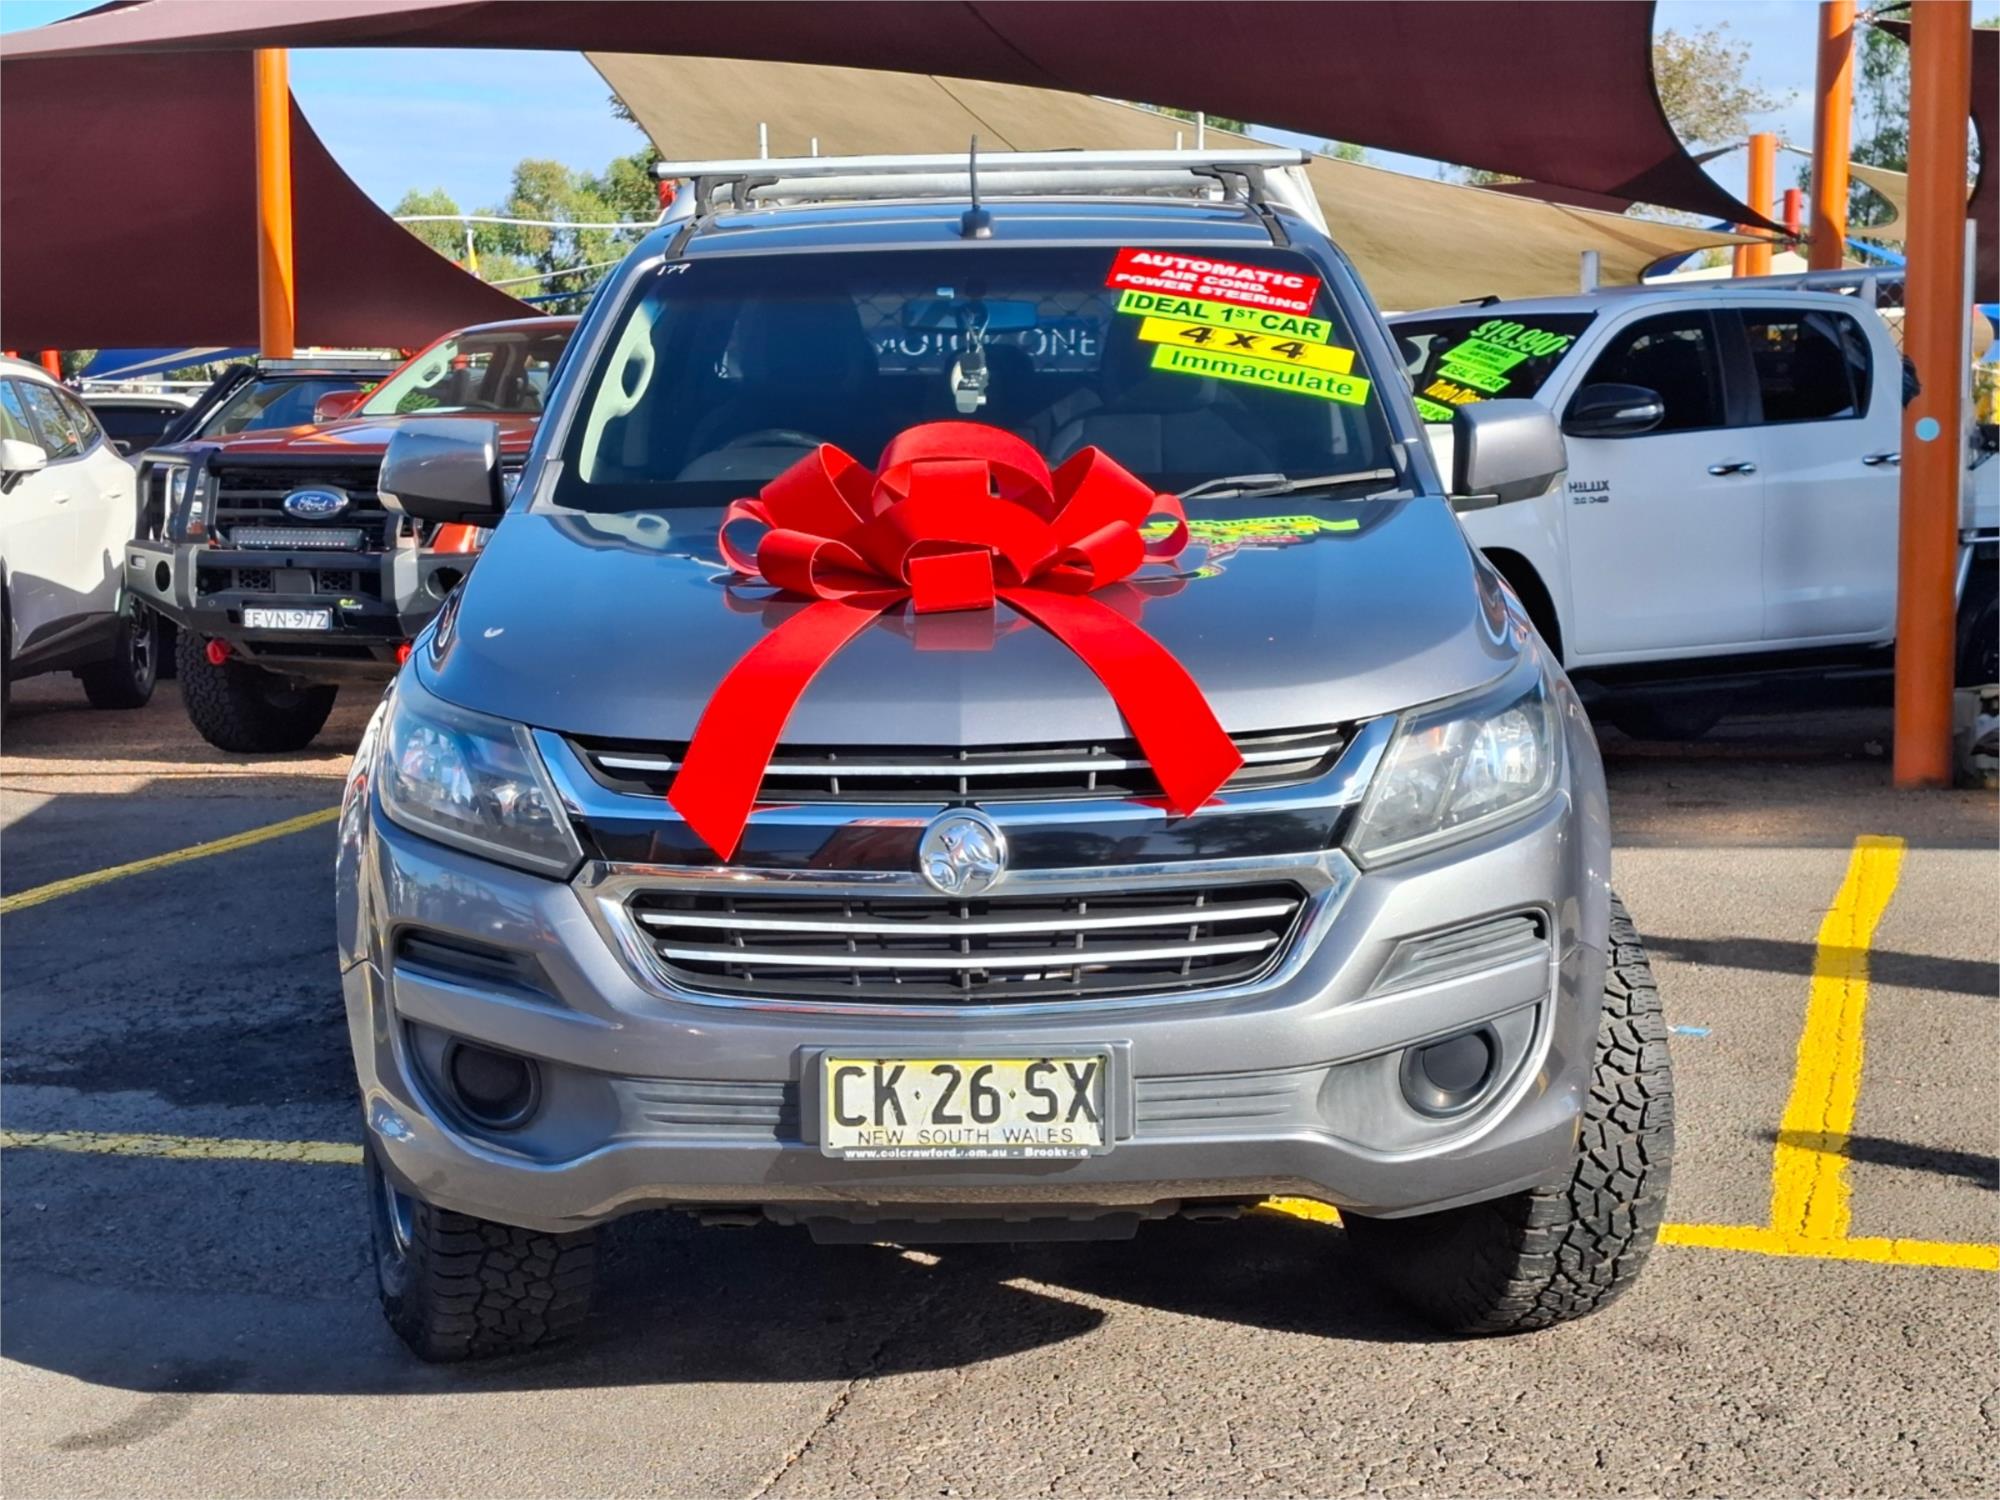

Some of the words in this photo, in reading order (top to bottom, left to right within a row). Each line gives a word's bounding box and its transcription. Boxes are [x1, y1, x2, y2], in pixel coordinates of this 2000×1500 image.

[1130, 253, 1304, 289] AUTOMATIC
[1160, 269, 1198, 283] AIR
[1203, 276, 1270, 294] COND.
[1115, 273, 1194, 292] POWER
[1198, 285, 1307, 312] STEERING
[1124, 292, 1210, 320] IDEAL
[1260, 314, 1322, 338] CAR
[1019, 328, 1096, 357] ONE
[1178, 326, 1214, 344] 4
[1271, 341, 1307, 360] 4
[1171, 350, 1353, 397] Immaculate
[298, 495, 332, 511] Ford
[857, 1129, 904, 1146] NEW
[918, 1128, 990, 1145] SOUTH
[1002, 1127, 1074, 1144] WALES
